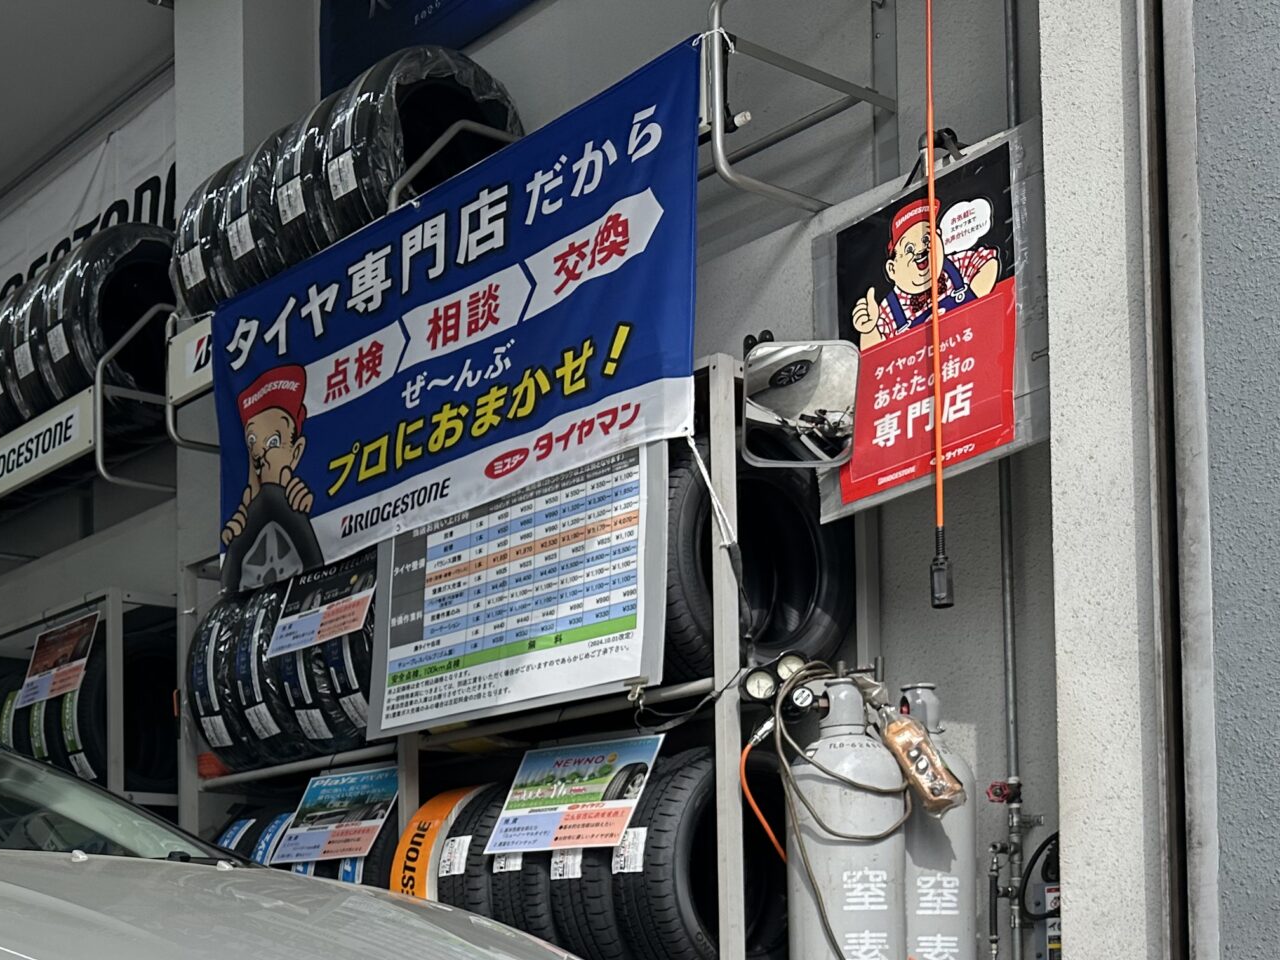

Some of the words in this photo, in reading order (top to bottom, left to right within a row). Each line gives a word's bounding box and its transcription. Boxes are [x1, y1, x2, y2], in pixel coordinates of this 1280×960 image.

[324, 341, 384, 403] 点検
[427, 284, 500, 351] 相談
[553, 210, 630, 295] 交換
[242, 380, 301, 409] BRIDGESTONE
[872, 382, 974, 447] 専門店
[493, 452, 524, 475] ミスター
[533, 402, 641, 461] タイヤマン
[945, 443, 975, 461] タイヤマン
[341, 477, 451, 539] BRIDGESTONE
[299, 568, 337, 585] REGNO
[552, 755, 605, 769] NEWNO
